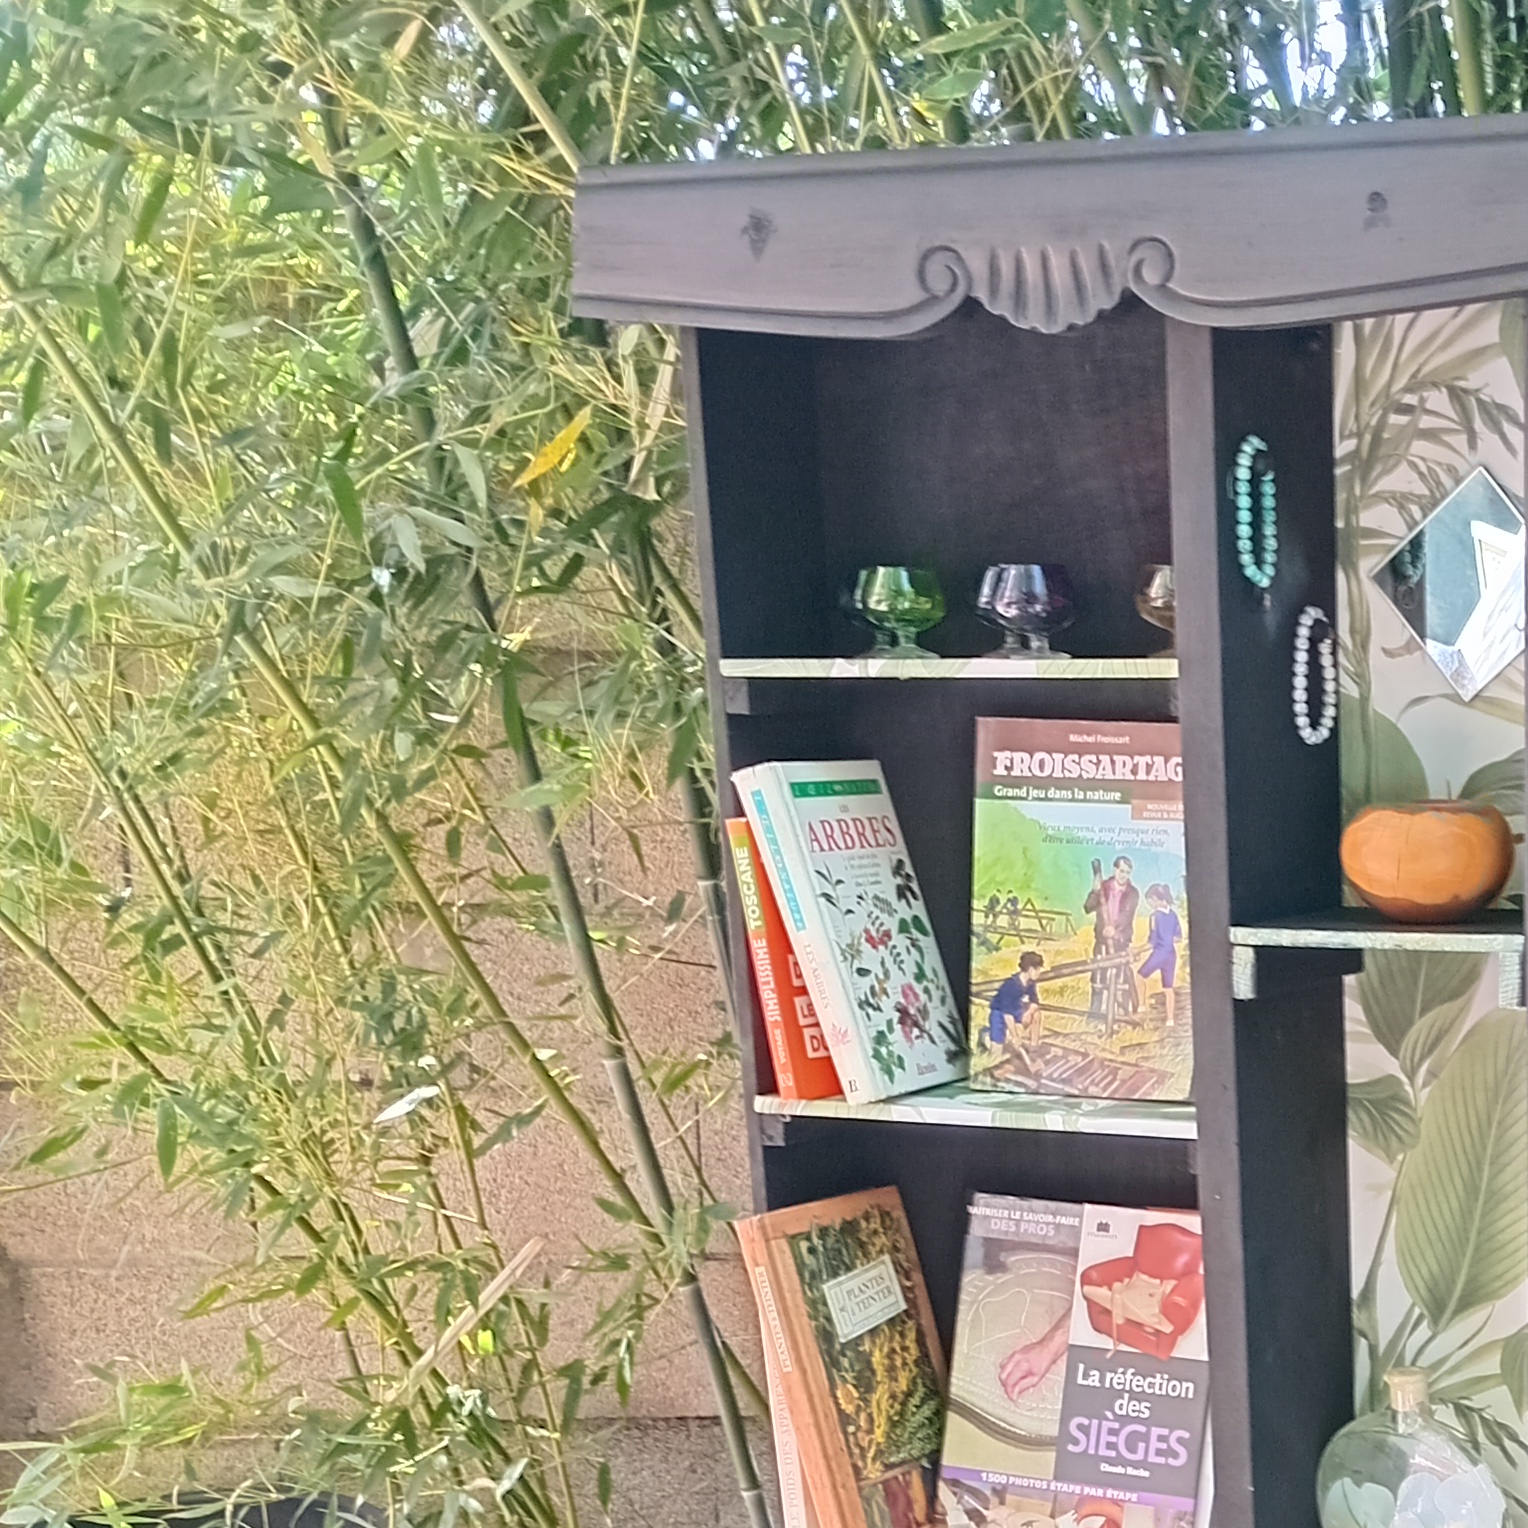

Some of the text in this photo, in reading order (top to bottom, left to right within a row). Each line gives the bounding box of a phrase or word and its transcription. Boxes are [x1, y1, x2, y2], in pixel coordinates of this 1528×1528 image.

[1069, 734, 1131, 745] Michel Froissart
[994, 785, 1122, 801] Grand jeu dans la nature
[807, 815, 898, 854] ARBRES
[736, 847, 763, 930] TOSCANE
[753, 937, 782, 1022] SIMPLISSIME
[774, 1028, 787, 1064] VOYAGE
[991, 1218, 1055, 1237] DES PROS
[1010, 1209, 1022, 1220] LE
[1022, 1211, 1080, 1226] SAVOIR-FAIRE
[846, 1273, 885, 1302] PLANTES
[1076, 1363, 1195, 1399] La réfection
[1114, 1394, 1151, 1419] des
[782, 1440, 793, 1466] DES
[1066, 1411, 1191, 1467] SIÈGES
[785, 1468, 799, 1509] POIDS
[1008, 1476, 1048, 1490] PHOTOS
[1050, 1479, 1082, 1495] ÉTAPE
[1083, 1485, 1104, 1498] PAR
[1105, 1487, 1139, 1502] ÉTAPE
